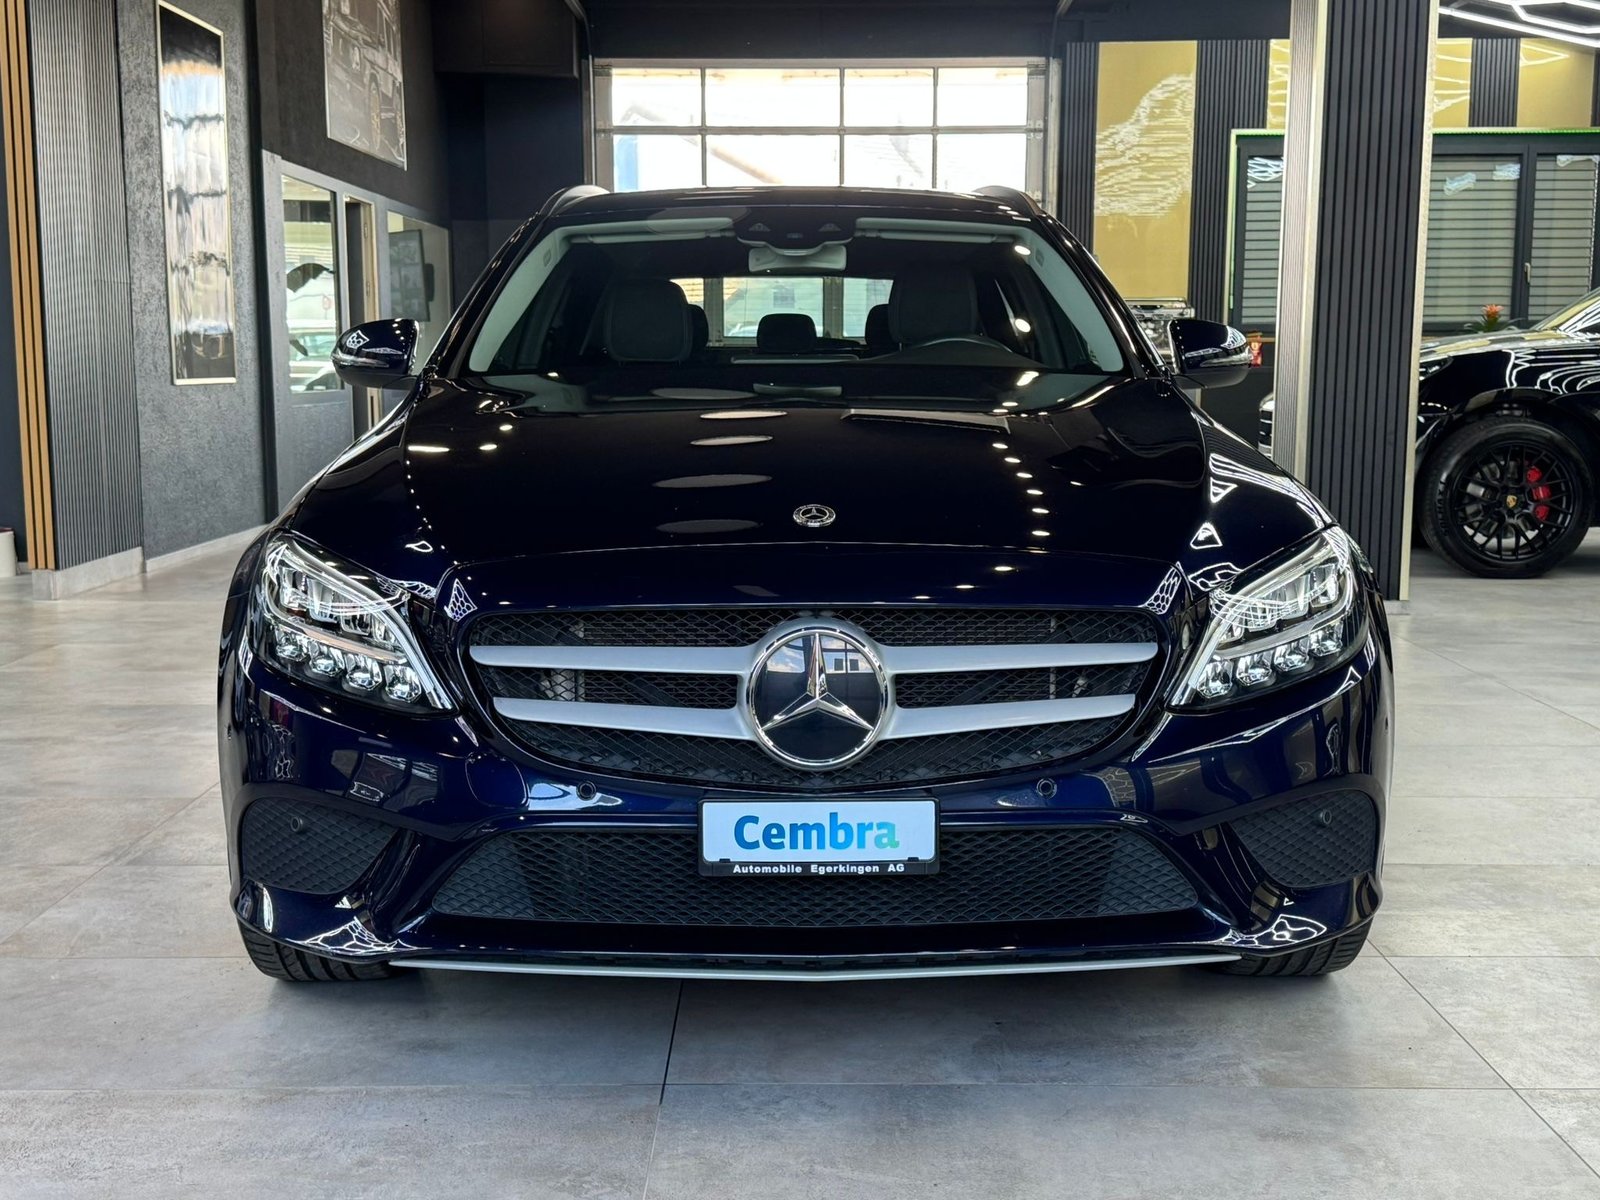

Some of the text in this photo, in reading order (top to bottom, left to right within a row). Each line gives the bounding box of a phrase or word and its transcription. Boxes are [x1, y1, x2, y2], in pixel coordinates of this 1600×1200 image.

[734, 812, 900, 850] Cembra
[733, 863, 905, 875] Automobile Egerkingen AG
